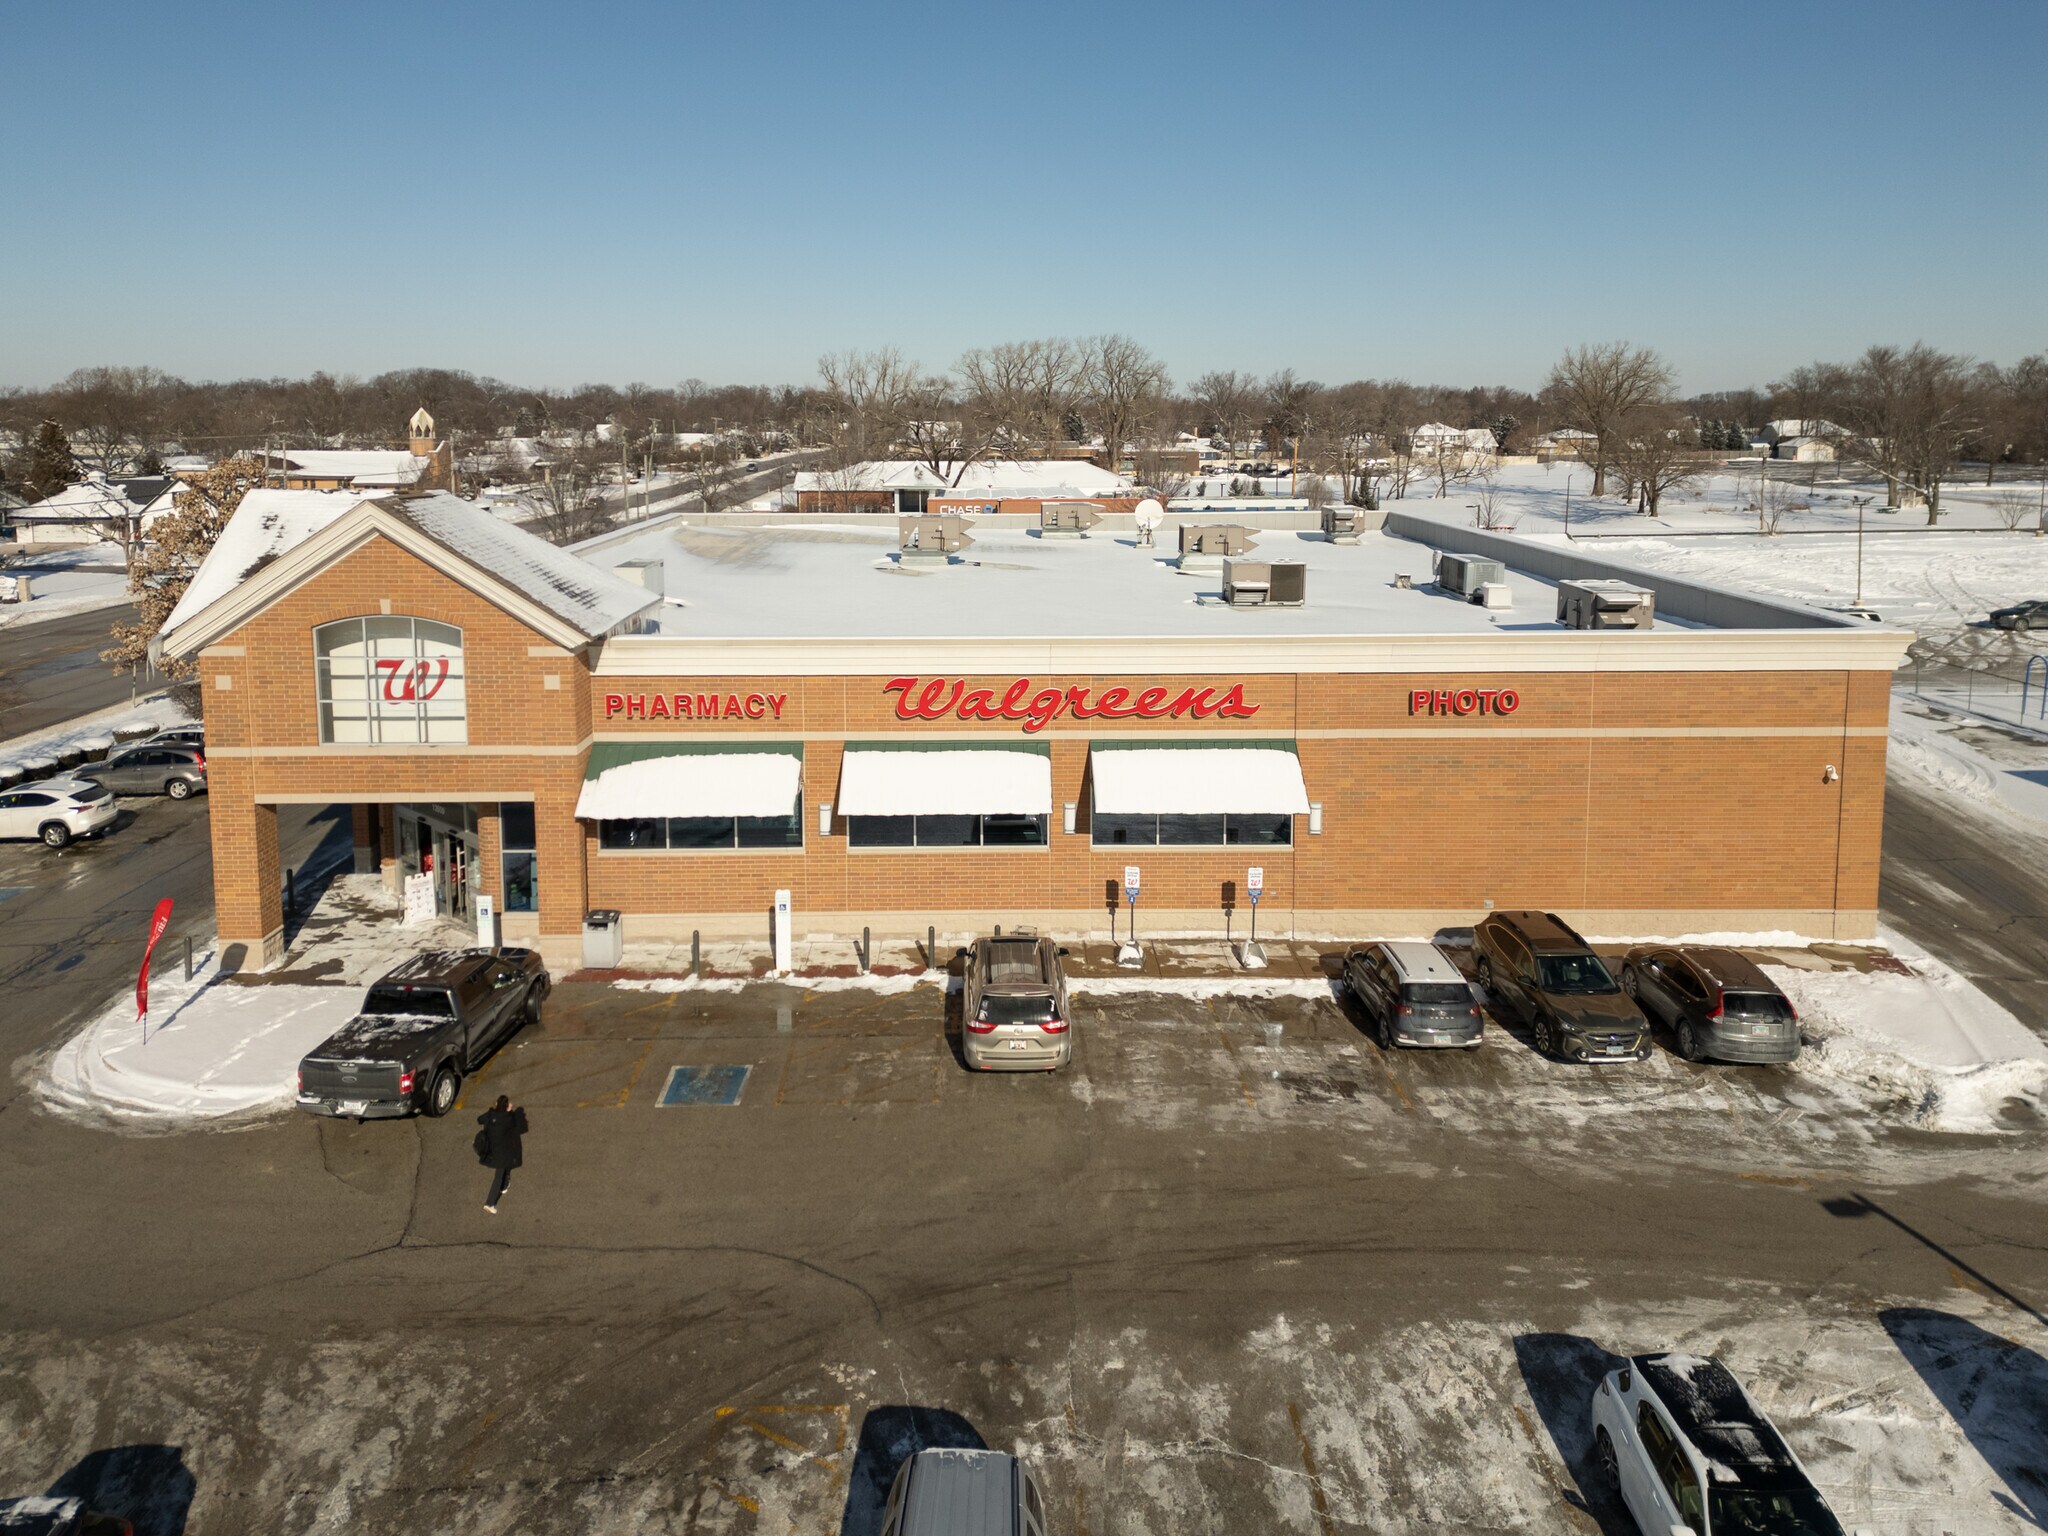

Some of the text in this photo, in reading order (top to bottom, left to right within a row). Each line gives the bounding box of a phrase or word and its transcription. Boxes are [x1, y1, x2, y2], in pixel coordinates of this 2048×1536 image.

[939, 505, 981, 514] CHASE
[376, 655, 449, 705] W
[605, 693, 788, 718] PHARMACY
[884, 677, 1261, 732] Walgreens
[1412, 688, 1520, 714] PHOTO
